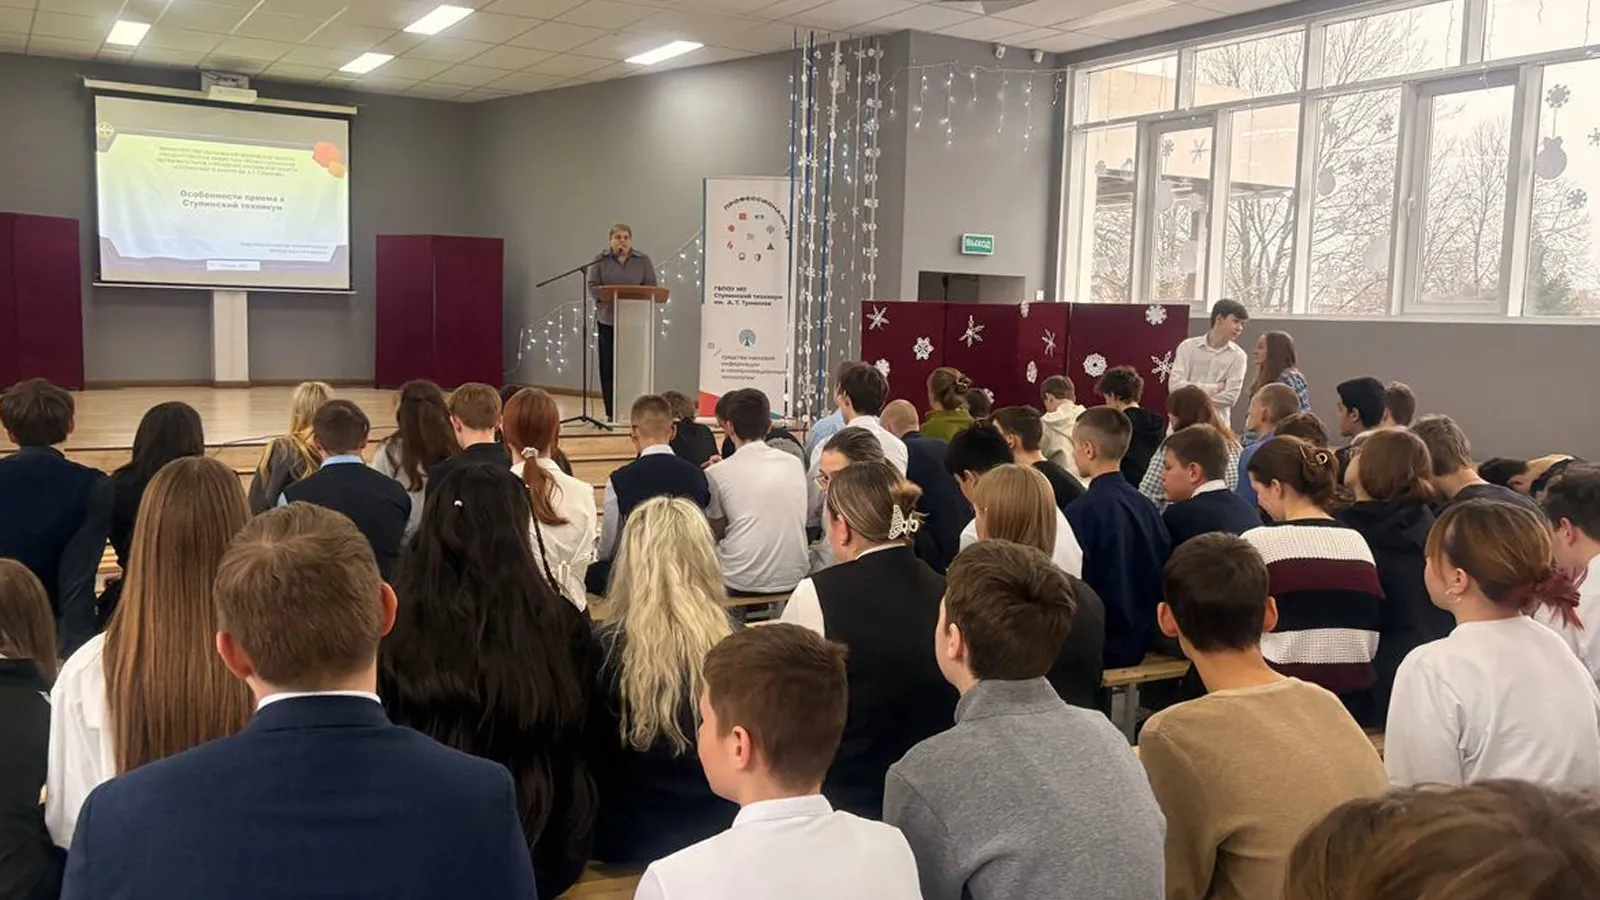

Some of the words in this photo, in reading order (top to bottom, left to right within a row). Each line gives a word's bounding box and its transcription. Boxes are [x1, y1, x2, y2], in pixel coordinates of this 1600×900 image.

[180, 189, 242, 200] Особенности
[244, 193, 278, 204] приема
[182, 198, 238, 210] Ступинский
[241, 203, 283, 212] техникум
[966, 238, 991, 249] ВЫХОД
